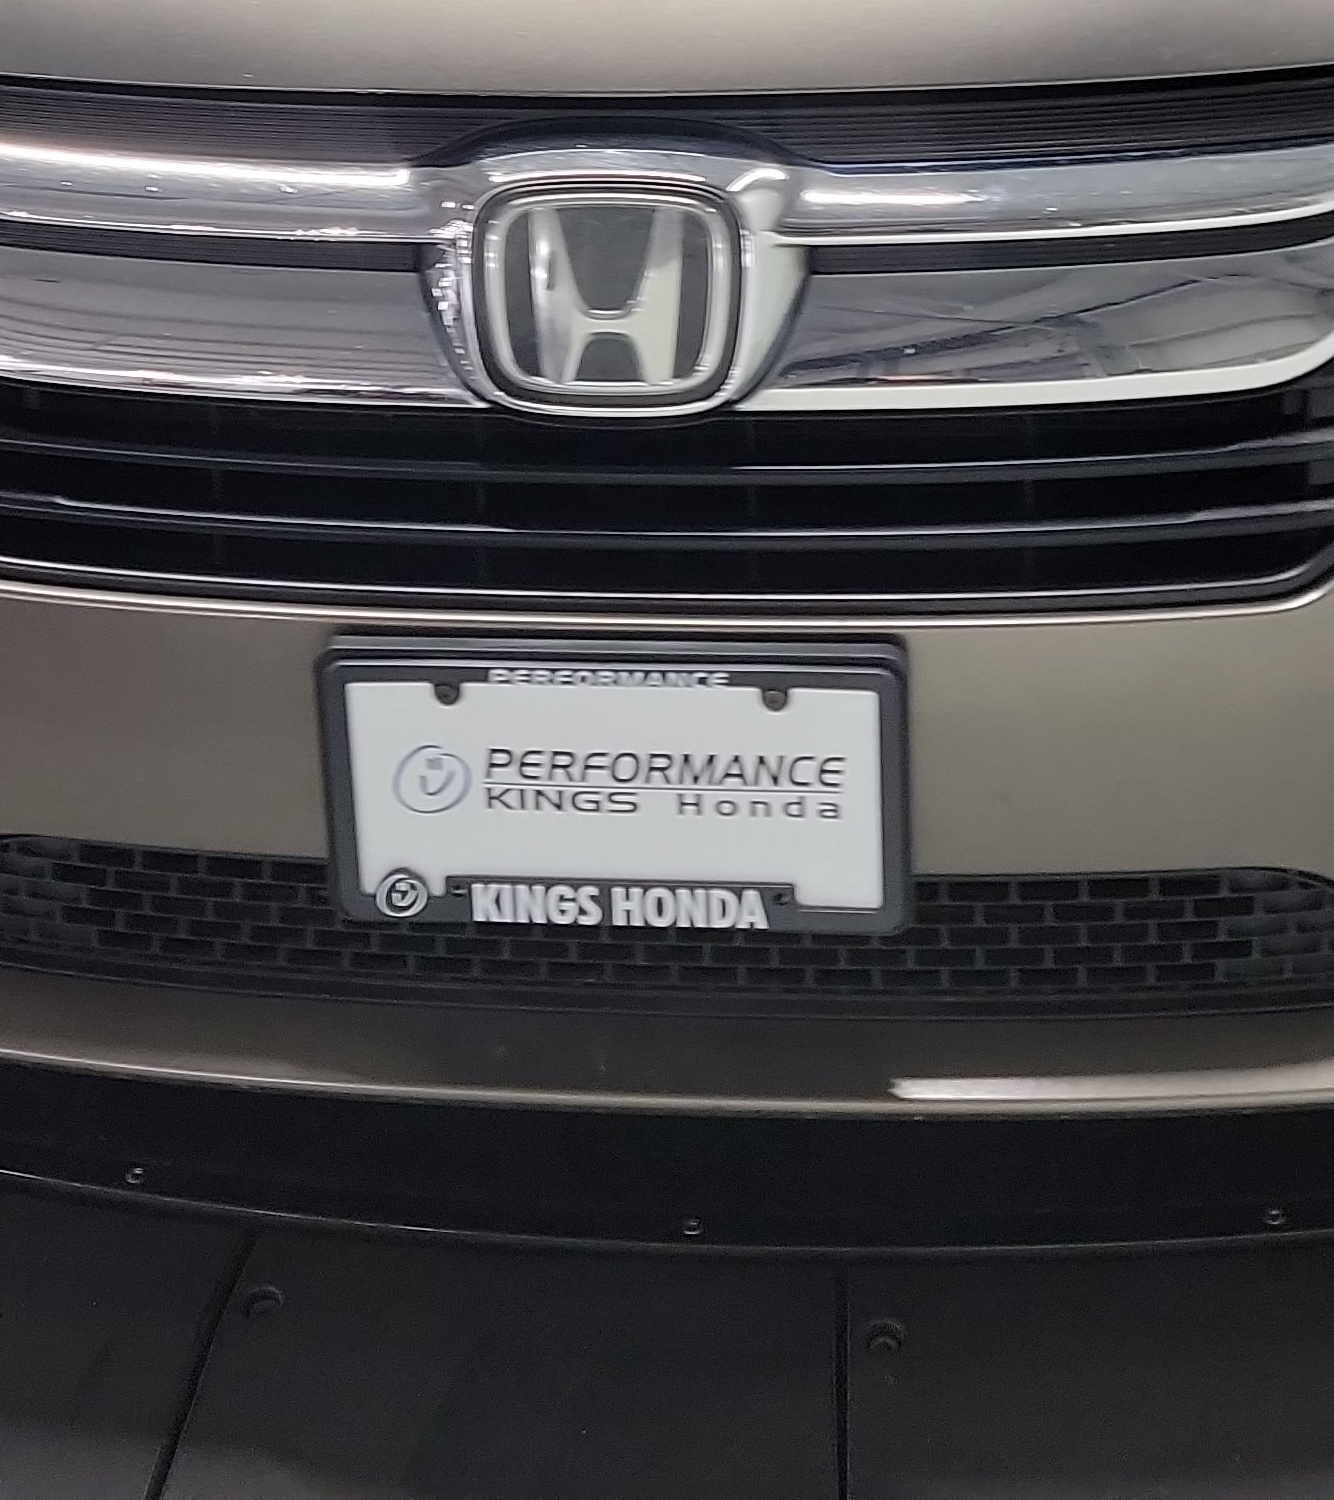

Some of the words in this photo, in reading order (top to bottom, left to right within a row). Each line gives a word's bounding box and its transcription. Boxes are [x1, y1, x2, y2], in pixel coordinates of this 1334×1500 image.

[487, 668, 731, 687] PERFORMANCE
[485, 747, 847, 788] PERFORMANCE
[485, 786, 640, 814] KINGS
[676, 792, 843, 820] Honda
[470, 882, 604, 926] KINGS
[610, 885, 770, 930] HONDA
